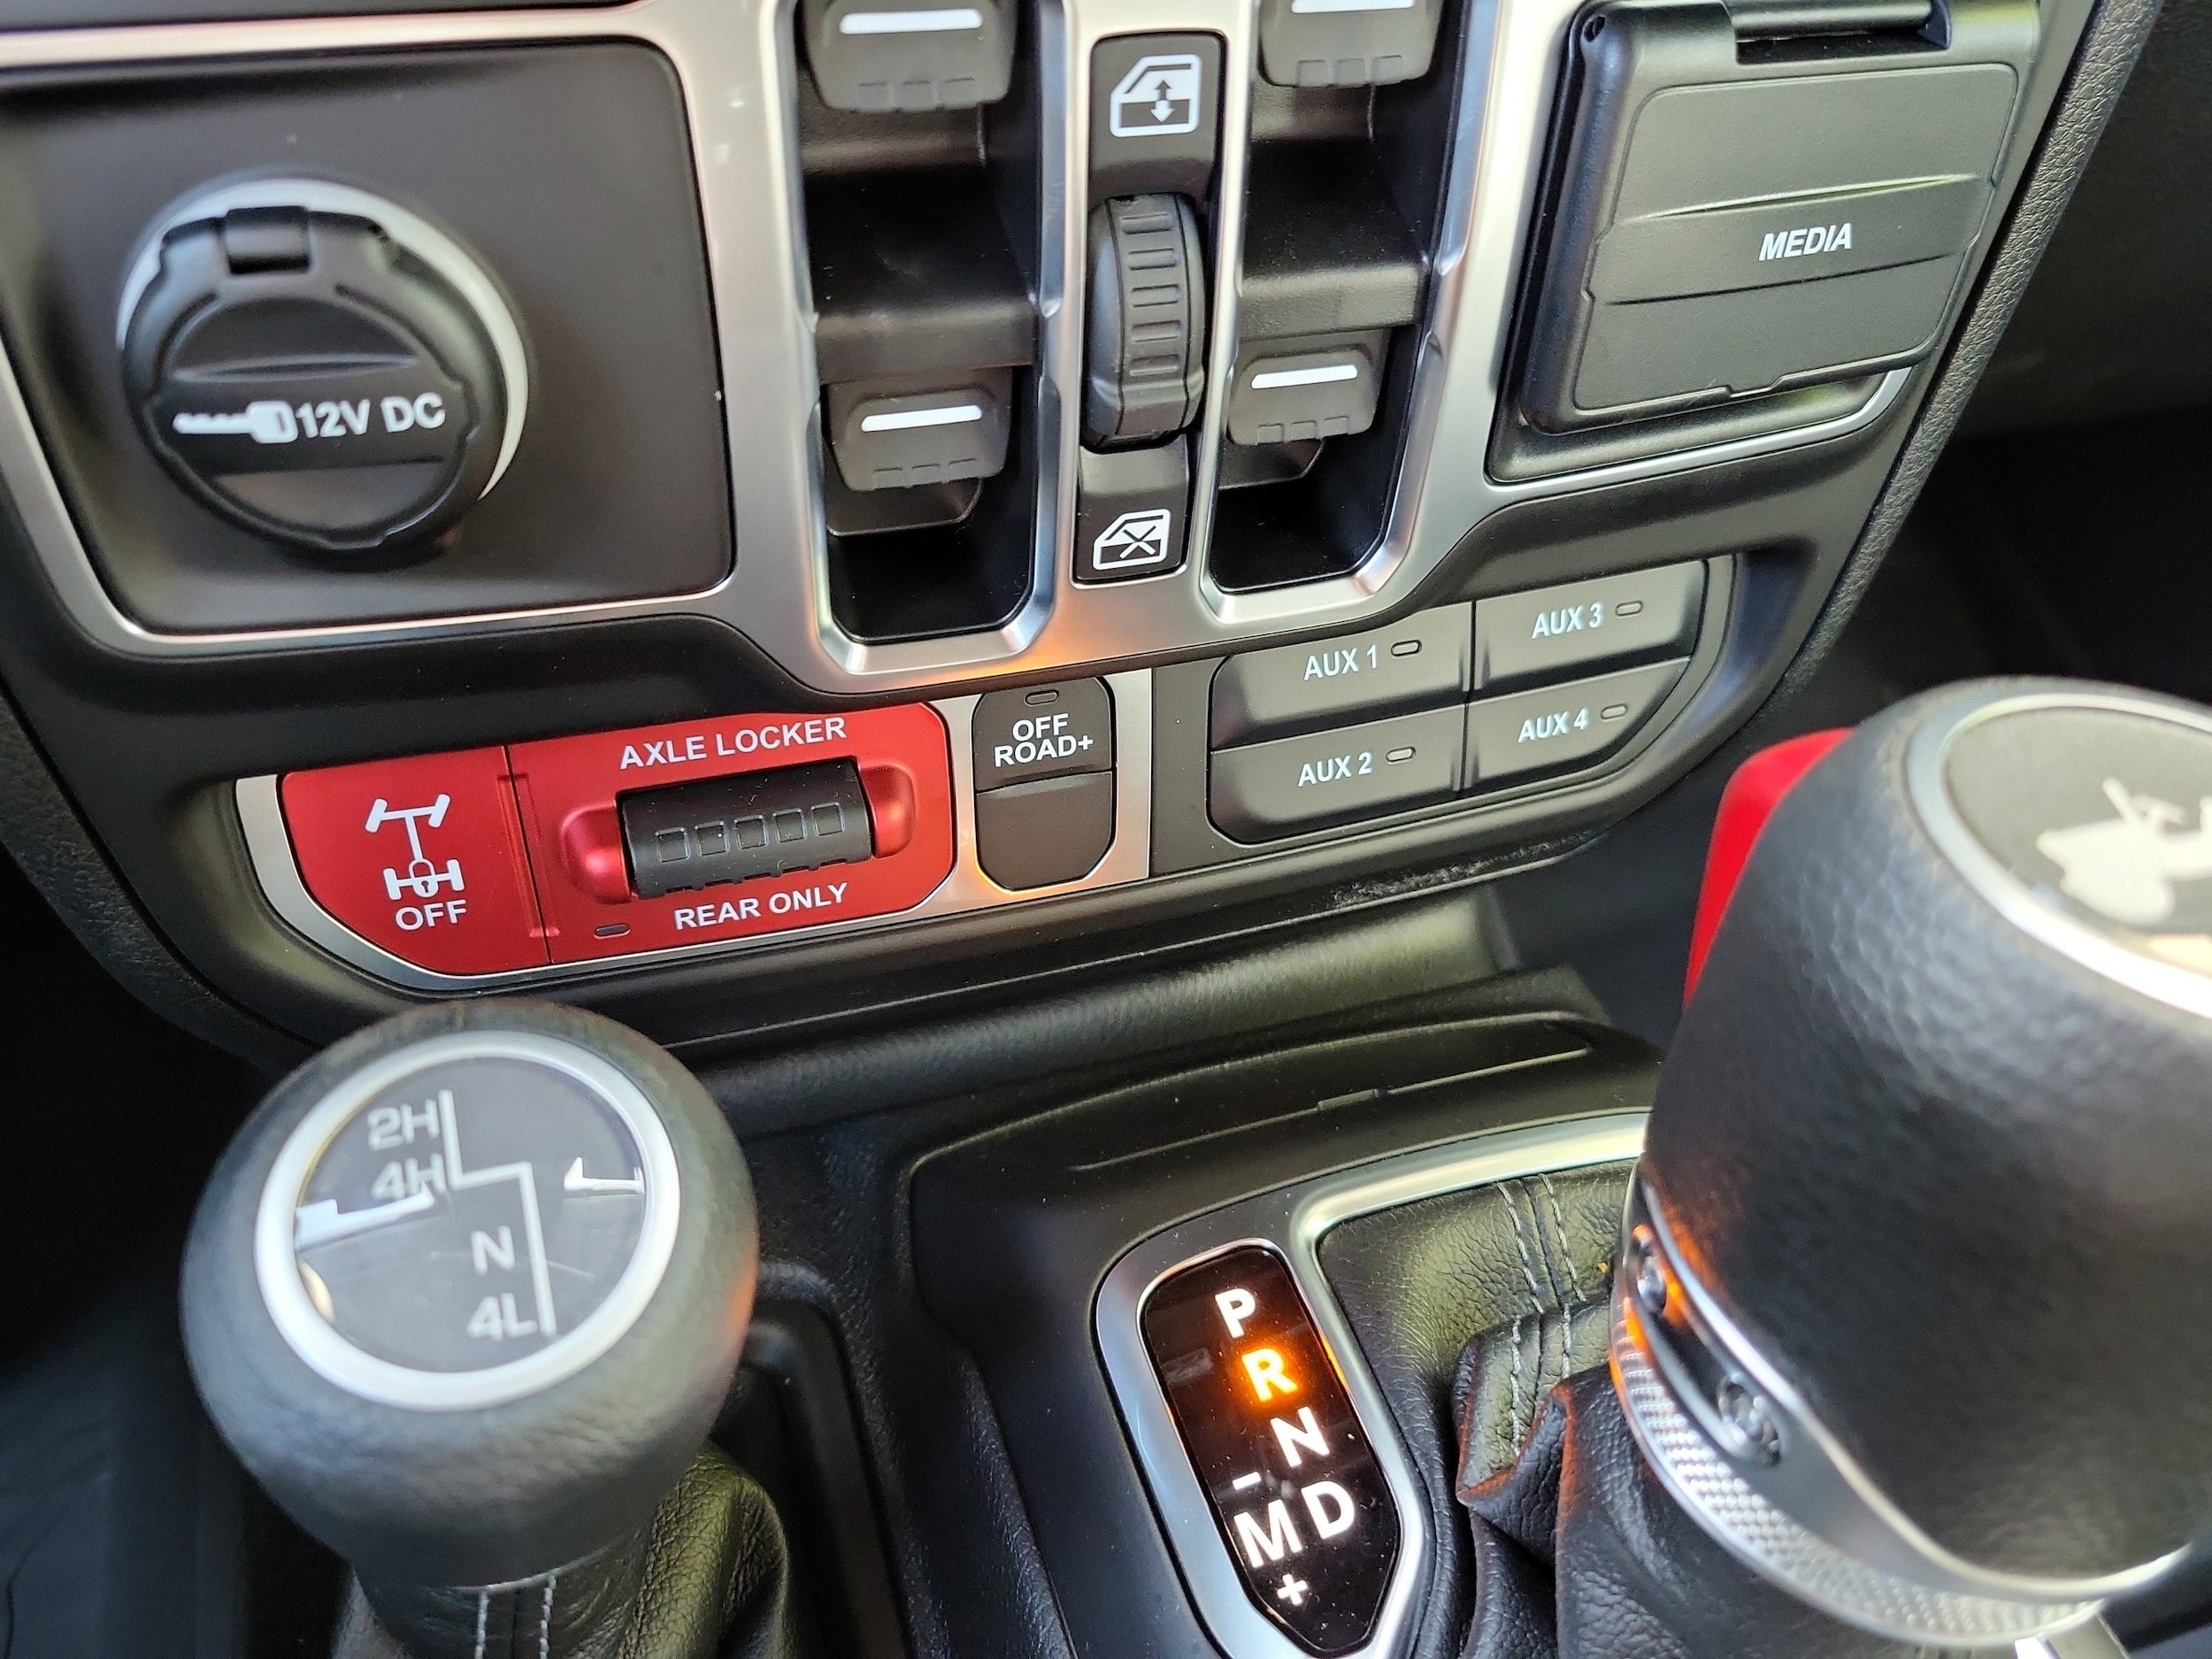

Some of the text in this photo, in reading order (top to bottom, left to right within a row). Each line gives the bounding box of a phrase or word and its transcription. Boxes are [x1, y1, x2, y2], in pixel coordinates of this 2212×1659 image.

[1758, 222, 1853, 262] MEDIA
[296, 392, 445, 439] 12V DC
[1531, 602, 1603, 639] AUX 3
[1303, 644, 1378, 680] AUX 1
[620, 717, 847, 769] AXLE LOCKER
[1011, 712, 1069, 743] OFF
[1517, 707, 1589, 743] AUX 4
[993, 733, 1094, 767] ROAD+
[1297, 752, 1372, 787] AUX 2
[395, 896, 468, 932] OFF
[674, 882, 848, 931] REAR ONLY
[367, 1099, 438, 1151] 2H
[372, 1154, 446, 1200] 4H
[472, 1226, 514, 1274] N
[466, 1293, 536, 1340] 4L
[1215, 1288, 1256, 1338] P
[1241, 1348, 1297, 1403] R
[1271, 1406, 1330, 1468] N
[1233, 1499, 1303, 1569] M
[1301, 1481, 1356, 1540] D
